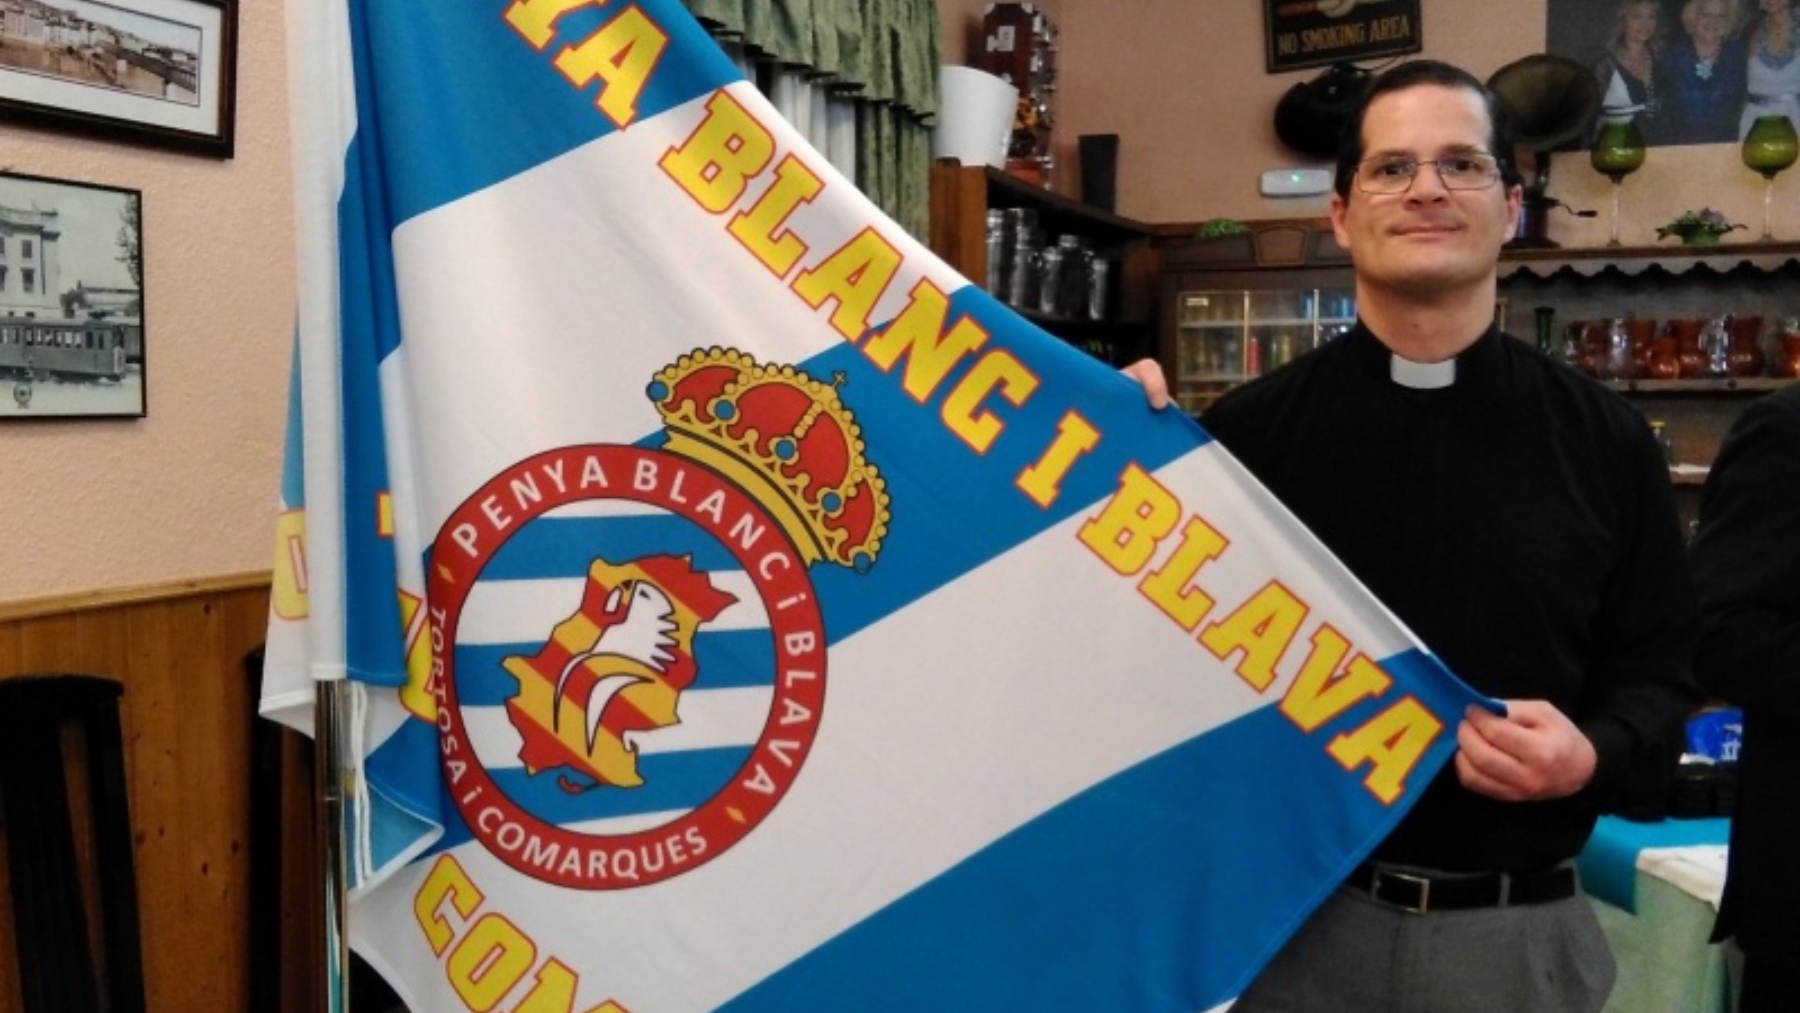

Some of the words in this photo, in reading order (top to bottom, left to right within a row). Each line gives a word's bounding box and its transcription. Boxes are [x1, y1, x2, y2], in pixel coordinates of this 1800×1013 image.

[1278, 33, 1298, 56] NO
[1302, 23, 1365, 51] SMOKING
[1370, 14, 1410, 43] AREA
[657, 86, 1041, 455] BLANC
[1014, 407, 1101, 511] I
[1075, 460, 1446, 808] BLAVA
[431, 607, 467, 784] TORTOSA
[476, 806, 709, 881] COMARQUES
[452, 456, 608, 558] PENYA
[632, 458, 793, 582] BLANC
[742, 630, 816, 796] BLAVA
